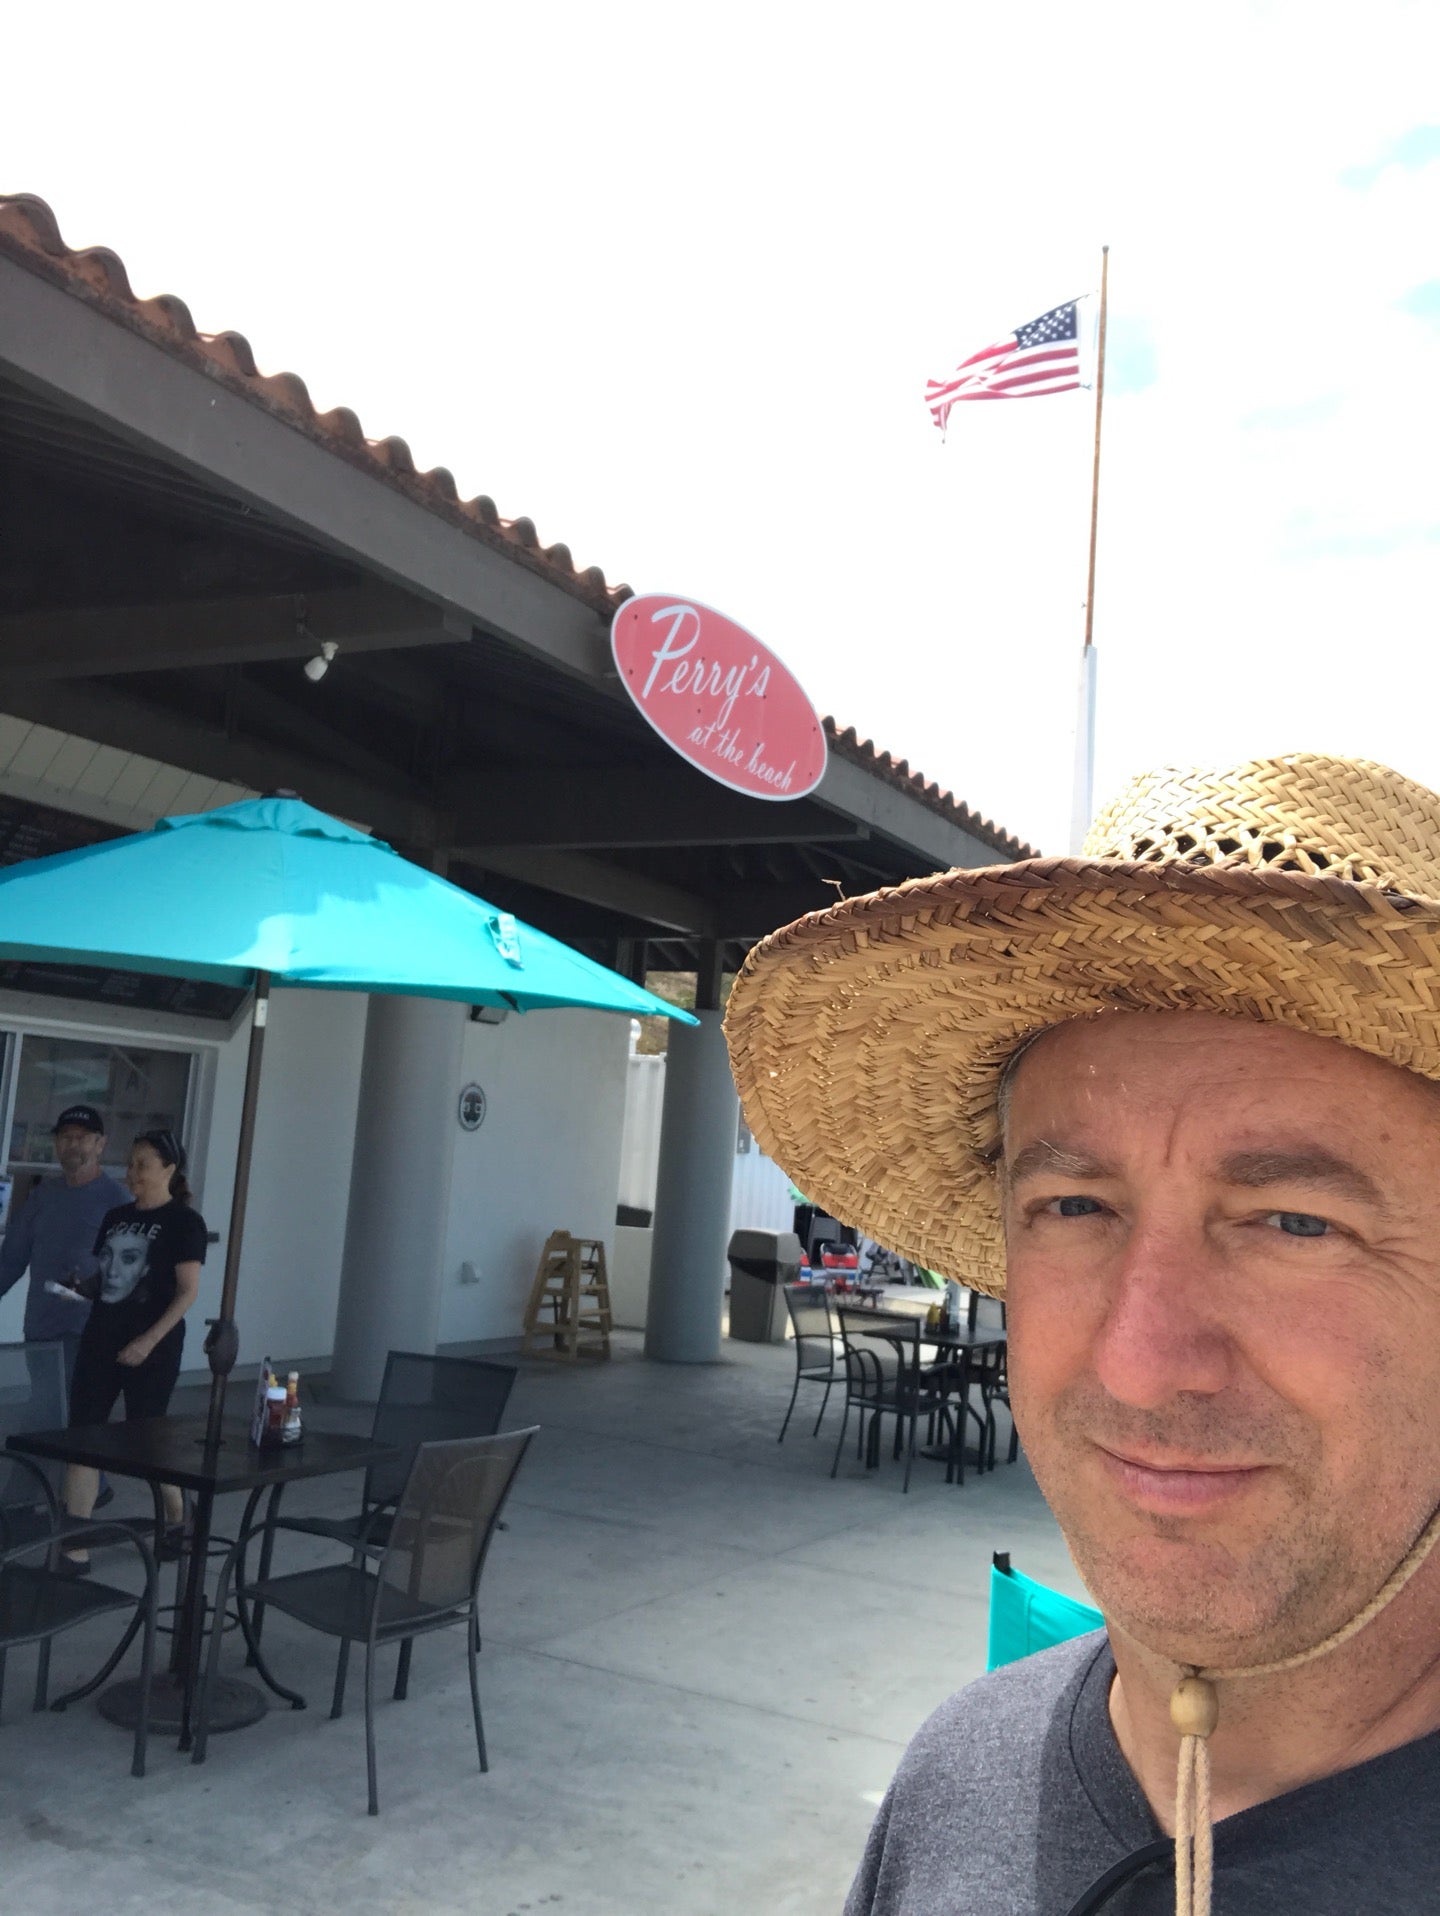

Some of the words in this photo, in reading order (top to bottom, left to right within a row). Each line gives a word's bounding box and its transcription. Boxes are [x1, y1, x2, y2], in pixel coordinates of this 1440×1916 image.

[641, 604, 771, 730] Perry's
[686, 721, 718, 748] at
[713, 728, 744, 766] the
[745, 742, 796, 792] beach
